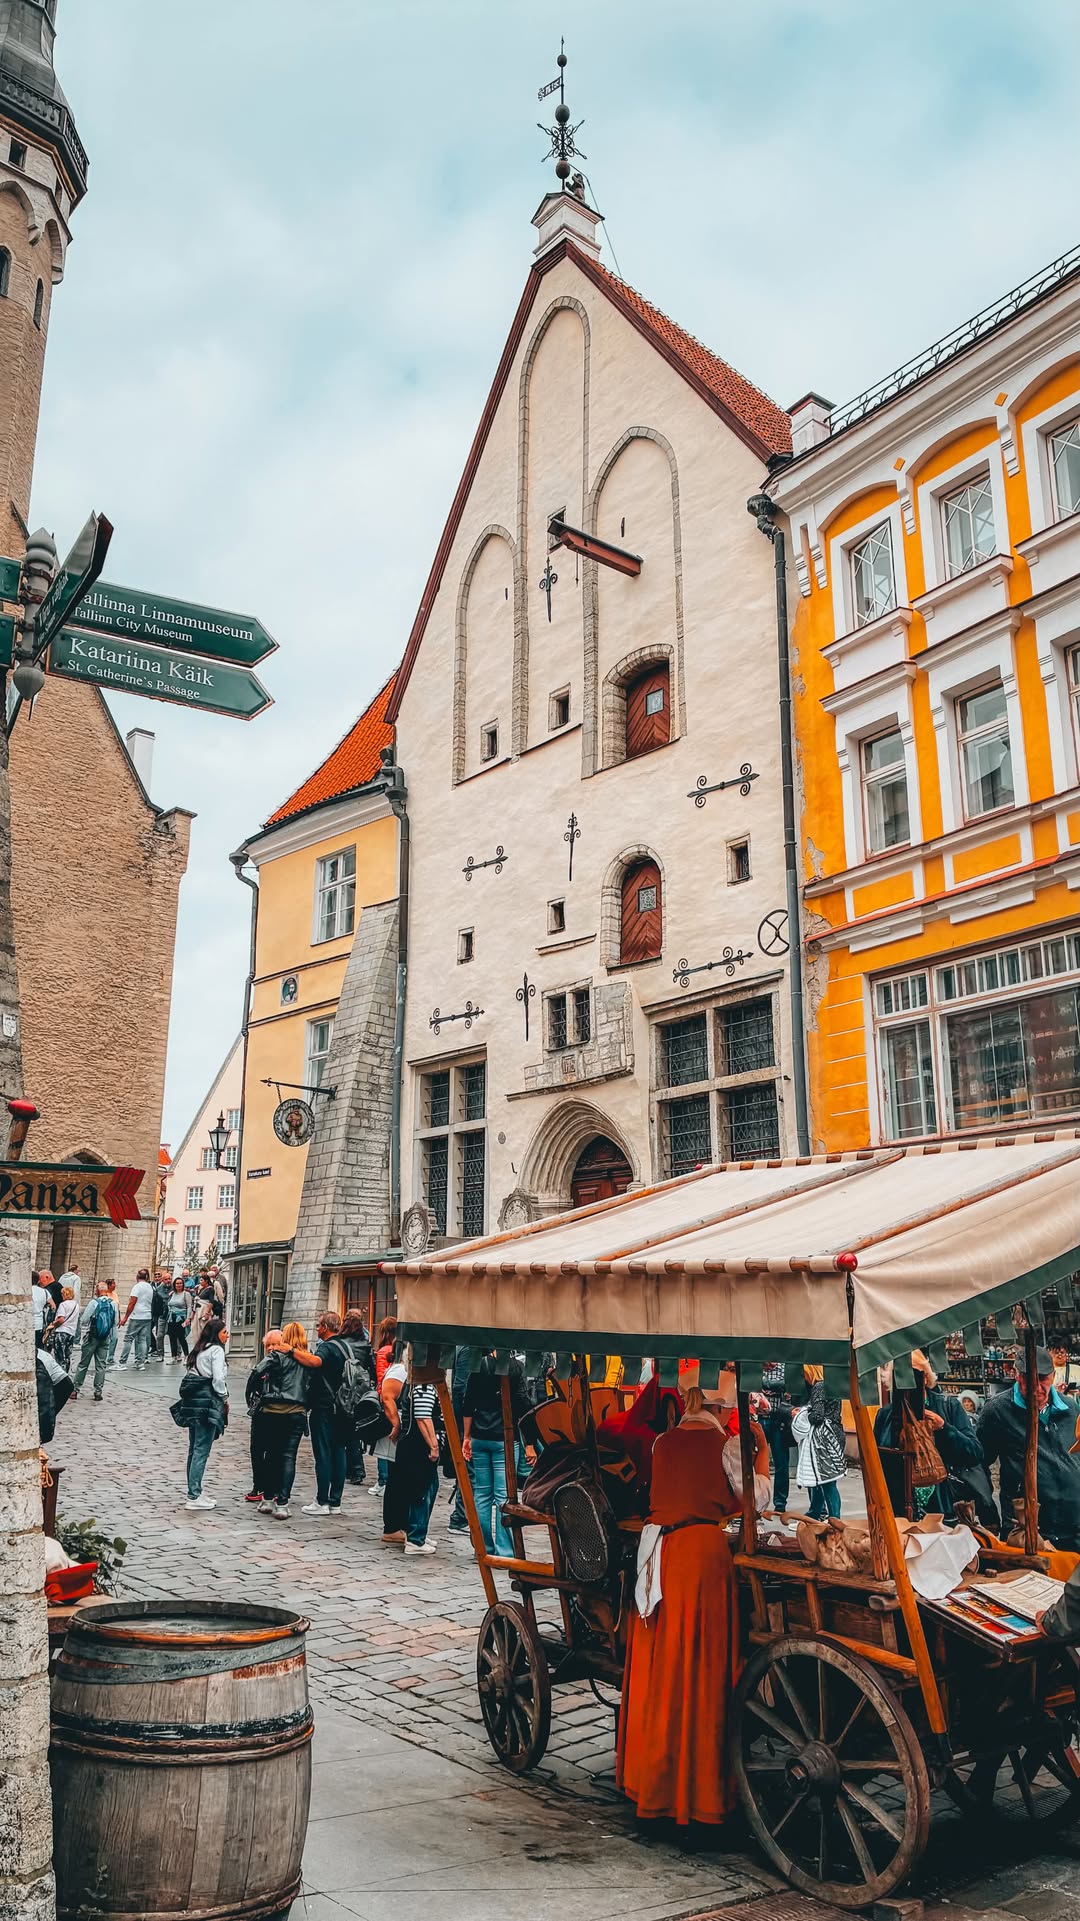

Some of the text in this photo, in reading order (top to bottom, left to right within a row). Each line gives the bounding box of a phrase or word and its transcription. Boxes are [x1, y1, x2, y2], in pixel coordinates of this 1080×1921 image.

[74, 607, 193, 642] Tallinn City Museum
[84, 593, 136, 614] allinna
[141, 604, 254, 641] Linnamuuseum
[67, 659, 83, 672] St.
[156, 680, 200, 699] Passage
[69, 637, 215, 687] Katariina Käik
